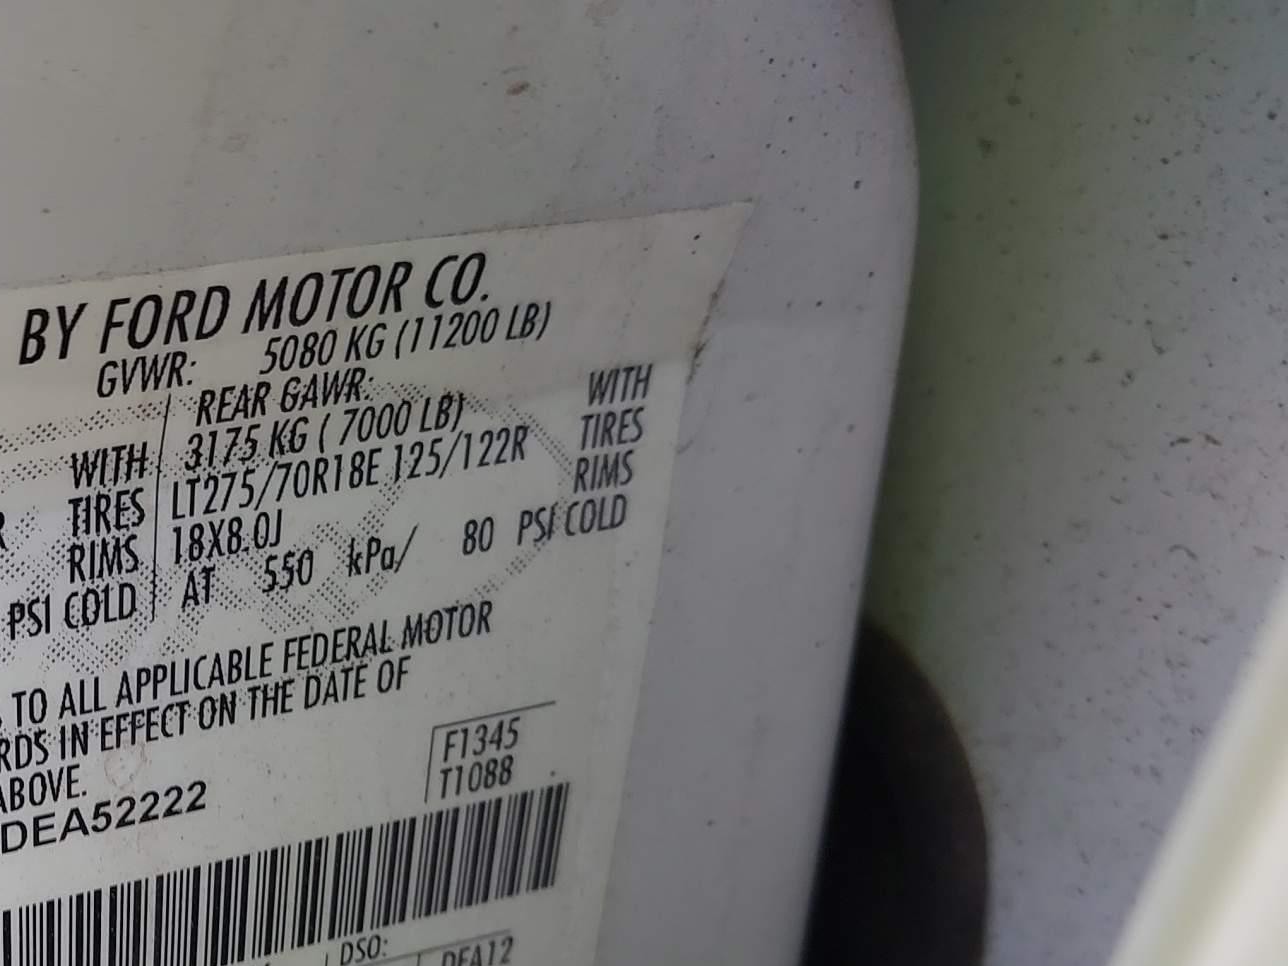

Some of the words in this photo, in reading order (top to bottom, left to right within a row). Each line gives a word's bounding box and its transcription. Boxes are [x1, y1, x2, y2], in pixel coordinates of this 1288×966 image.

[19, 302, 89, 366] BY
[100, 285, 230, 354] FORD
[242, 260, 414, 334] MOTOR
[423, 252, 489, 308] CO.
[96, 355, 196, 399] GVWR:
[259, 330, 336, 377] 5080
[345, 323, 386, 363] KG
[394, 308, 500, 360] (11200
[507, 301, 552, 342] LB)
[195, 382, 272, 426] REAR
[280, 367, 374, 415] GAWR:
[586, 363, 655, 406] WITH
[183, 422, 258, 472] 3175
[268, 418, 311, 457] KG
[418, 392, 465, 434] LB)
[579, 406, 645, 450] TIRES
[70, 441, 150, 489] WITH
[171, 454, 383, 520] LT275/70R18E
[392, 425, 529, 483] 125/122R
[573, 449, 635, 494] RIMS
[68, 488, 146, 537] TIRES
[172, 509, 284, 566] 18X8.0J
[66, 537, 141, 584] RIMS
[180, 568, 215, 610] AT
[260, 549, 314, 594] 550
[347, 523, 420, 577] kPa/
[462, 517, 495, 556] 80
[516, 504, 556, 548] PSI
[563, 494, 629, 536] COLD
[10, 593, 52, 641] PSI
[64, 583, 137, 630] COLD
[12, 687, 47, 729] TO
[58, 677, 107, 719] ALL
[115, 642, 275, 708] APPLICABLE
[282, 624, 393, 673] FEDERAL
[400, 600, 493, 650] MOTOR
[59, 717, 89, 759] IN
[99, 701, 187, 751] EFFECT
[198, 692, 238, 731] ON
[248, 679, 295, 721] THE
[303, 664, 368, 711] DATE
[376, 655, 412, 693] OF
[442, 716, 521, 763] F1345
[438, 754, 515, 800] T1088
